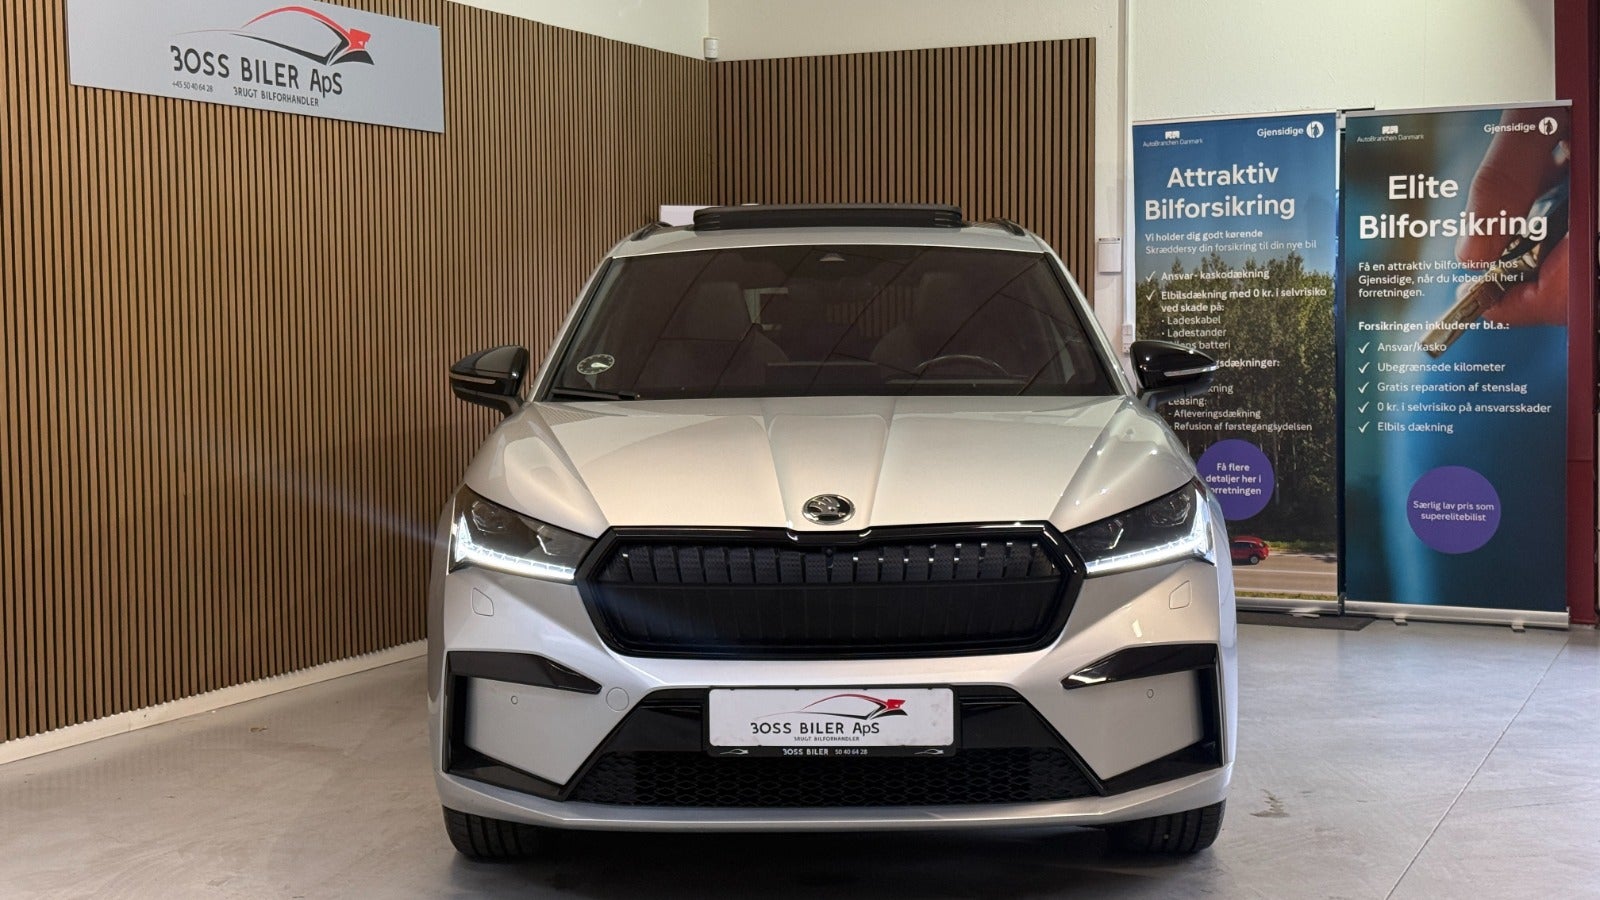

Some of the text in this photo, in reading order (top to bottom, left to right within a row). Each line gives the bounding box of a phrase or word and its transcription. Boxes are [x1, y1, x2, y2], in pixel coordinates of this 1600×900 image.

[241, 57, 299, 89] BILER
[310, 68, 343, 98] ApS
[261, 91, 319, 107] BILFORHANDLER
[1257, 127, 1304, 137] Gjensidige
[1483, 123, 1536, 134] Gjensidige
[1167, 162, 1279, 188] Attraktiv
[1388, 173, 1459, 200] Elite
[1145, 194, 1295, 220] Bilforsikring
[1359, 210, 1548, 241] Bilforsikring
[1145, 229, 1263, 242] Vi holder dig godt kørende
[1145, 240, 1317, 255] Skræddersy din forsikring til din nye bil
[1358, 262, 1370, 271] Få
[1387, 262, 1431, 271] attraktiv
[1434, 260, 1497, 271] bilforsikring
[1499, 260, 1519, 269] hos
[1161, 269, 1270, 281] Ansvar- kaskodækning
[1358, 274, 1415, 286] Gjensidige,
[1417, 273, 1435, 284] når
[1436, 274, 1450, 283] du
[1452, 273, 1482, 283] køber
[1484, 273, 1497, 282] bil
[1500, 273, 1518, 282] her
[1161, 290, 1228, 301] Elbilsdækning
[1229, 289, 1250, 298] med
[1254, 289, 1260, 298] 0
[1262, 288, 1274, 297] kr.
[1281, 287, 1327, 297] selvrisiko
[1358, 288, 1425, 299] forretningen.
[1161, 301, 1224, 314] ved skade på:
[1167, 315, 1221, 325] Ladeskabel
[1358, 321, 1423, 332] Forsikringen
[1425, 320, 1480, 330] inkluderer
[1167, 328, 1227, 338] Ladestander
[1199, 341, 1231, 350] batteri
[1377, 342, 1447, 353] Ansvar/kasko
[1216, 358, 1280, 369] gsdækninger:
[1377, 362, 1506, 374] Ubegrænsede kilometer
[1377, 382, 1528, 394] Gratis reparation af stenslag
[1377, 403, 1384, 412] 0
[1386, 402, 1399, 412] kr.
[1407, 402, 1456, 412] selvrisiko
[1458, 402, 1472, 414] på
[1474, 403, 1551, 413] ansvarsskader
[1173, 409, 1261, 420] Afleveringsdækning
[1174, 421, 1313, 433] Refusion af førstegangsydelsen
[1377, 422, 1454, 434] Elbils dækning
[1216, 462, 1250, 472] Få flere
[1205, 474, 1239, 485] detaljer
[1241, 474, 1257, 483] her
[1210, 486, 1262, 497] orretningen
[1413, 501, 1441, 511] Særlig
[1442, 501, 1455, 509] lav
[1457, 502, 1473, 511] pris
[1420, 513, 1487, 521] superelitebilist
[800, 722, 844, 734] BILER
[852, 722, 880, 736] ApS
